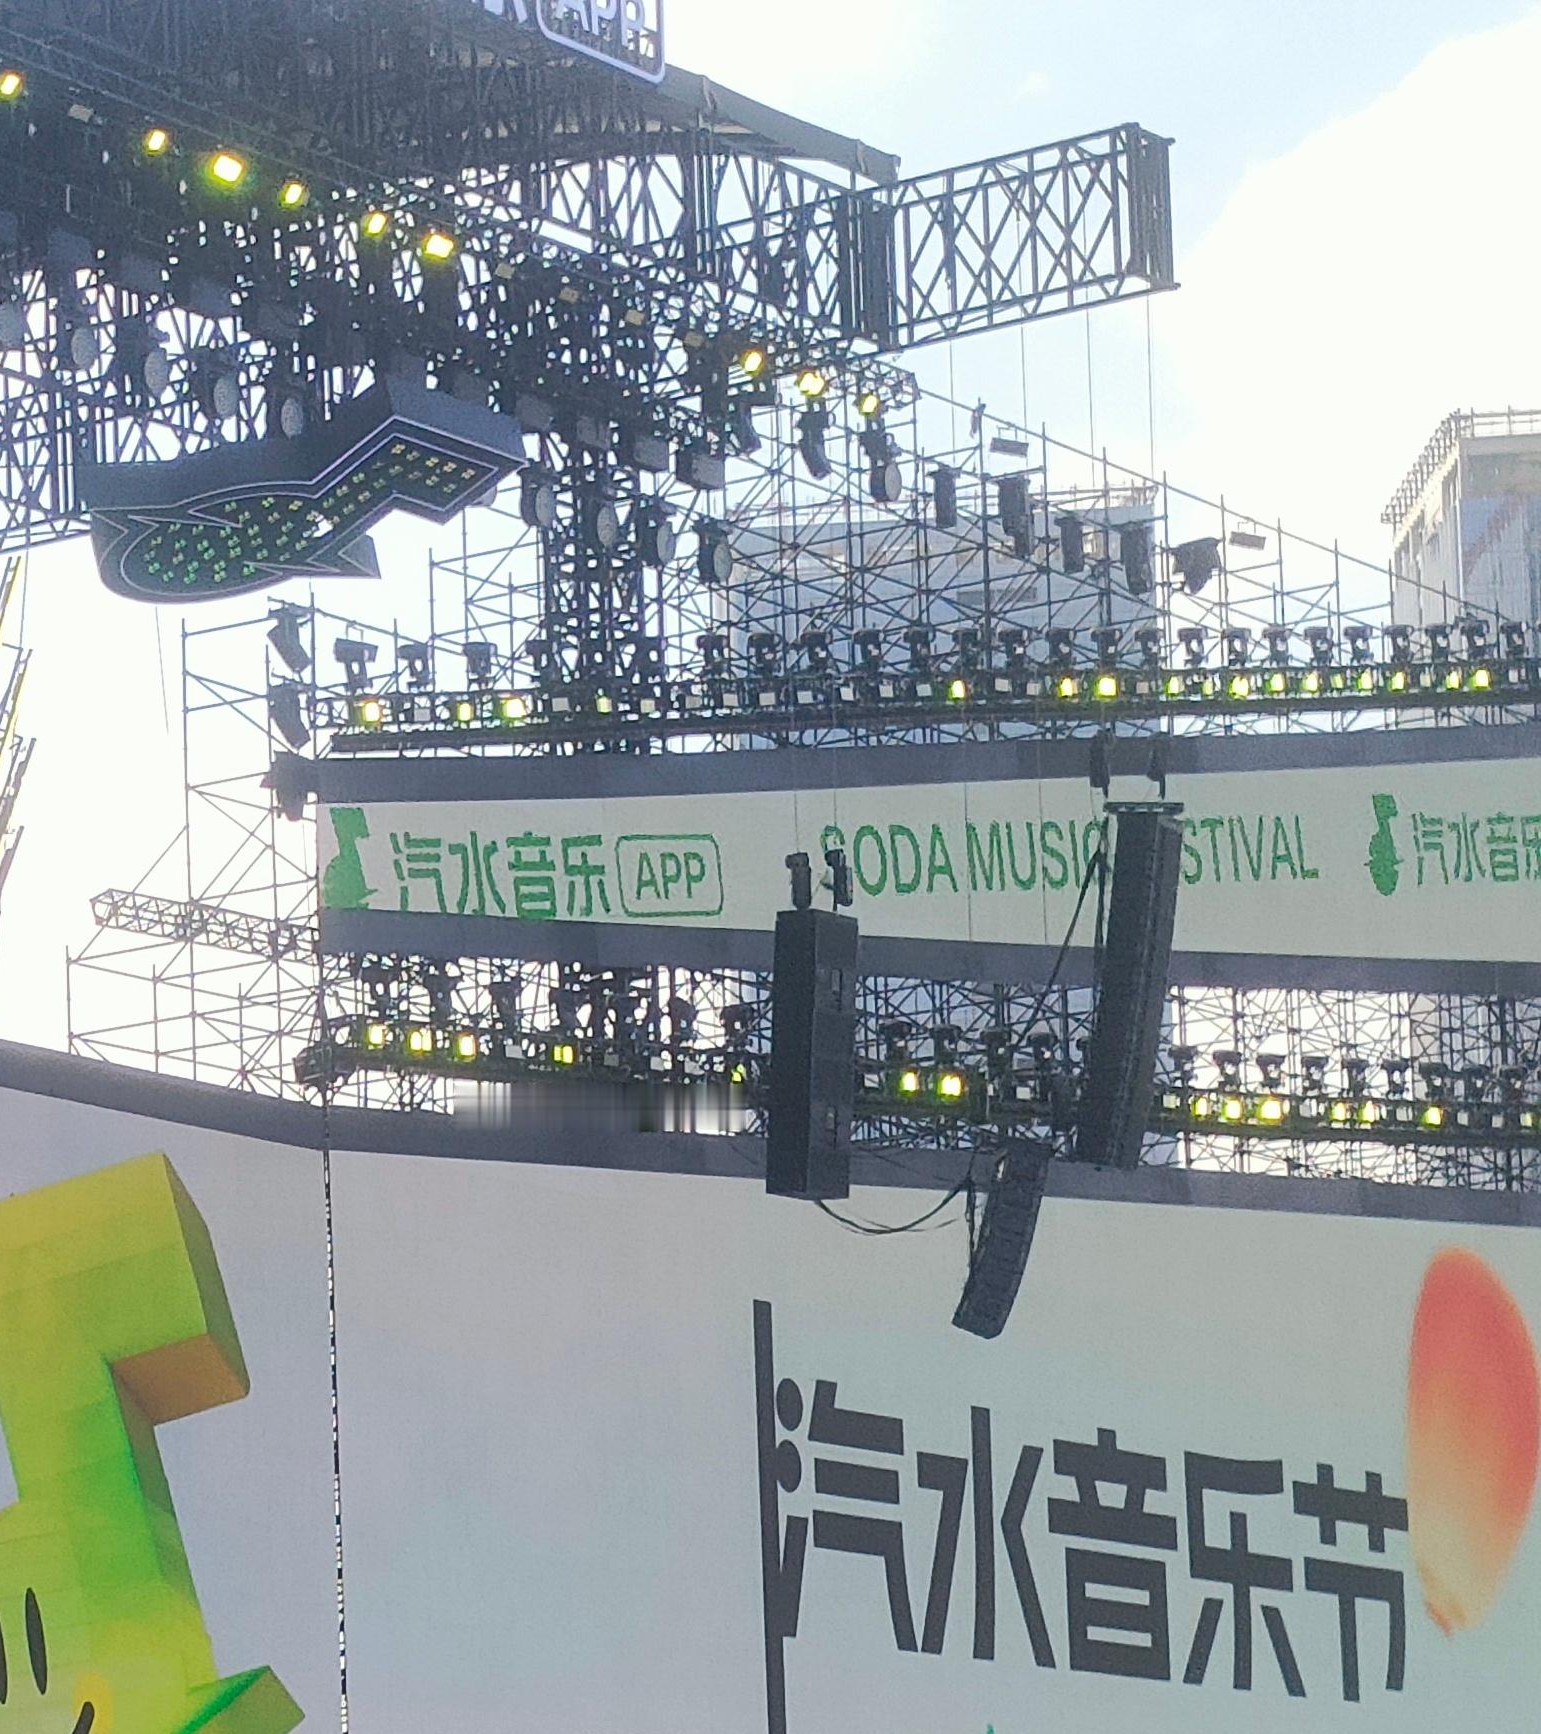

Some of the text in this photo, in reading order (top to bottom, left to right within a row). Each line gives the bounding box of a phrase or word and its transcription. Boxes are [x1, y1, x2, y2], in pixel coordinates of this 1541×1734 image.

[389, 830, 707, 919] 汽水音乐 APP
[1182, 814, 1319, 886] STIVAL
[773, 1377, 1409, 1702] 汽水音乐节
